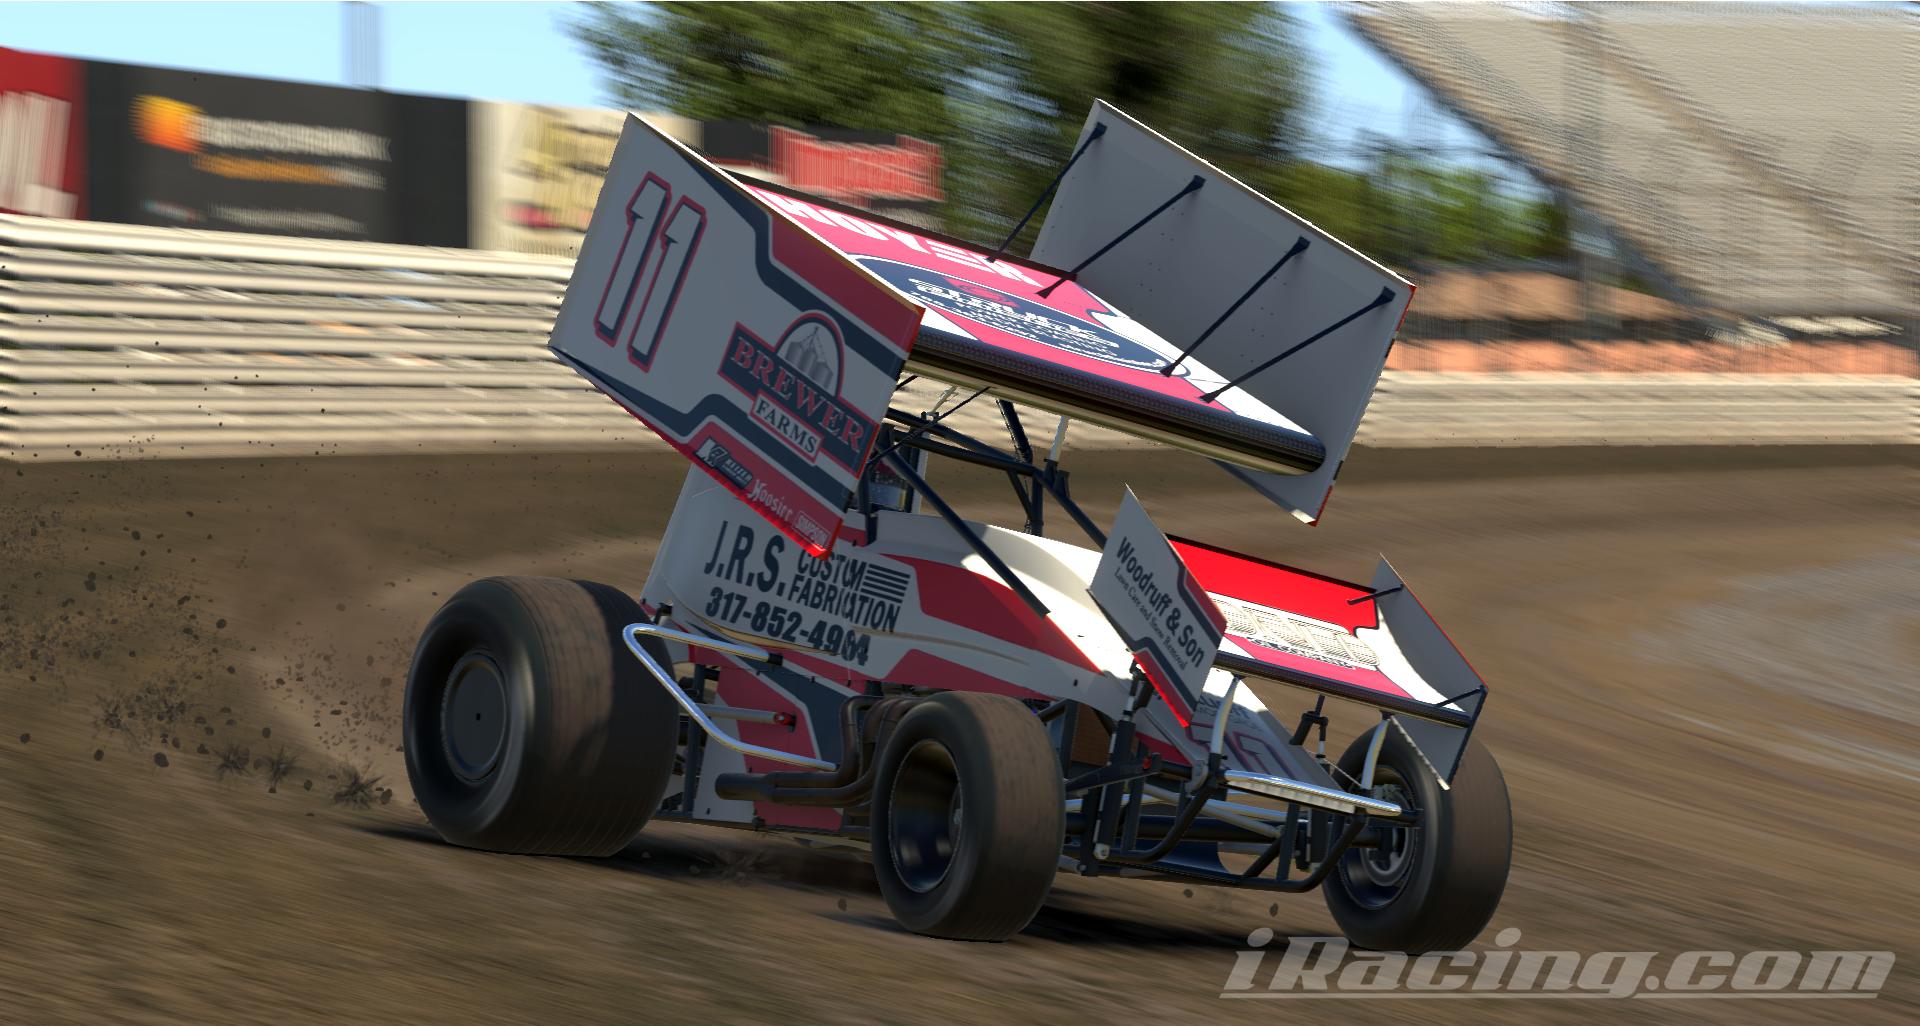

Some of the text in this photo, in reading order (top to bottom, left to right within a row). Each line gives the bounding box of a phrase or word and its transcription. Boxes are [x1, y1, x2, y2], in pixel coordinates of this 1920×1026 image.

[594, 171, 707, 373] 11
[731, 336, 865, 453] BREWER
[755, 399, 820, 456] FARMS
[746, 478, 793, 521] Hoosier
[704, 520, 786, 597] J.R.S.
[797, 549, 868, 591] CUSTOM
[705, 586, 871, 667] 317-852-4984
[788, 574, 900, 633] FABRICATION
[1117, 536, 1205, 668] Woodruff & Son
